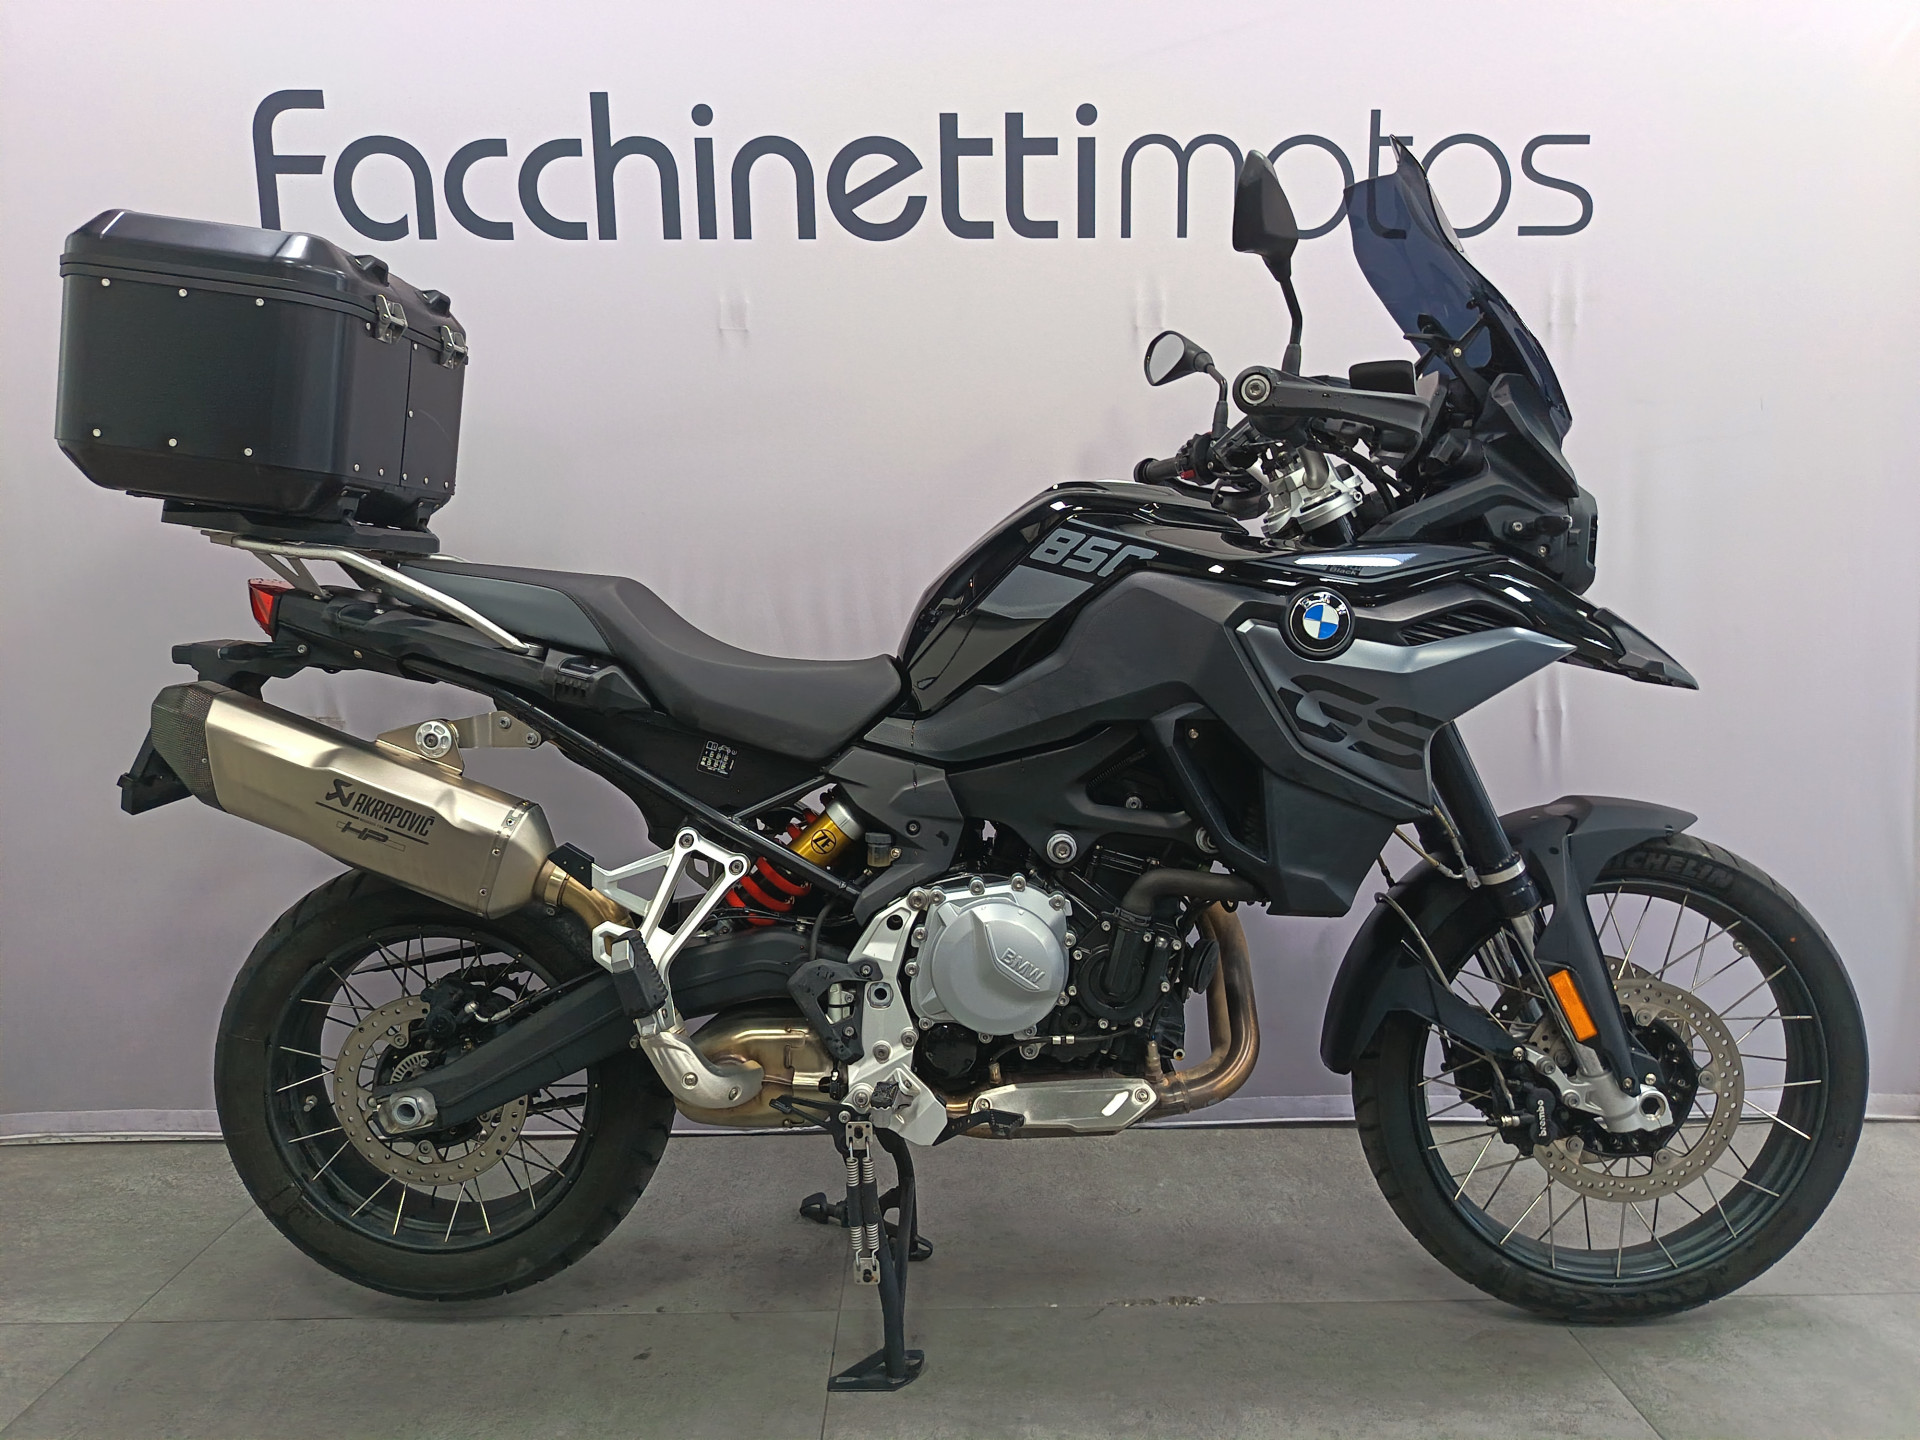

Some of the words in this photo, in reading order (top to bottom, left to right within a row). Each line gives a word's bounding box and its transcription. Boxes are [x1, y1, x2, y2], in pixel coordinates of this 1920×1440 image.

[340, 821, 390, 843] HP
[812, 829, 836, 854] ZF
[1606, 850, 1735, 889] ICHELIN
[1001, 948, 1046, 981] BMW
[1536, 1099, 1547, 1137] brembo
